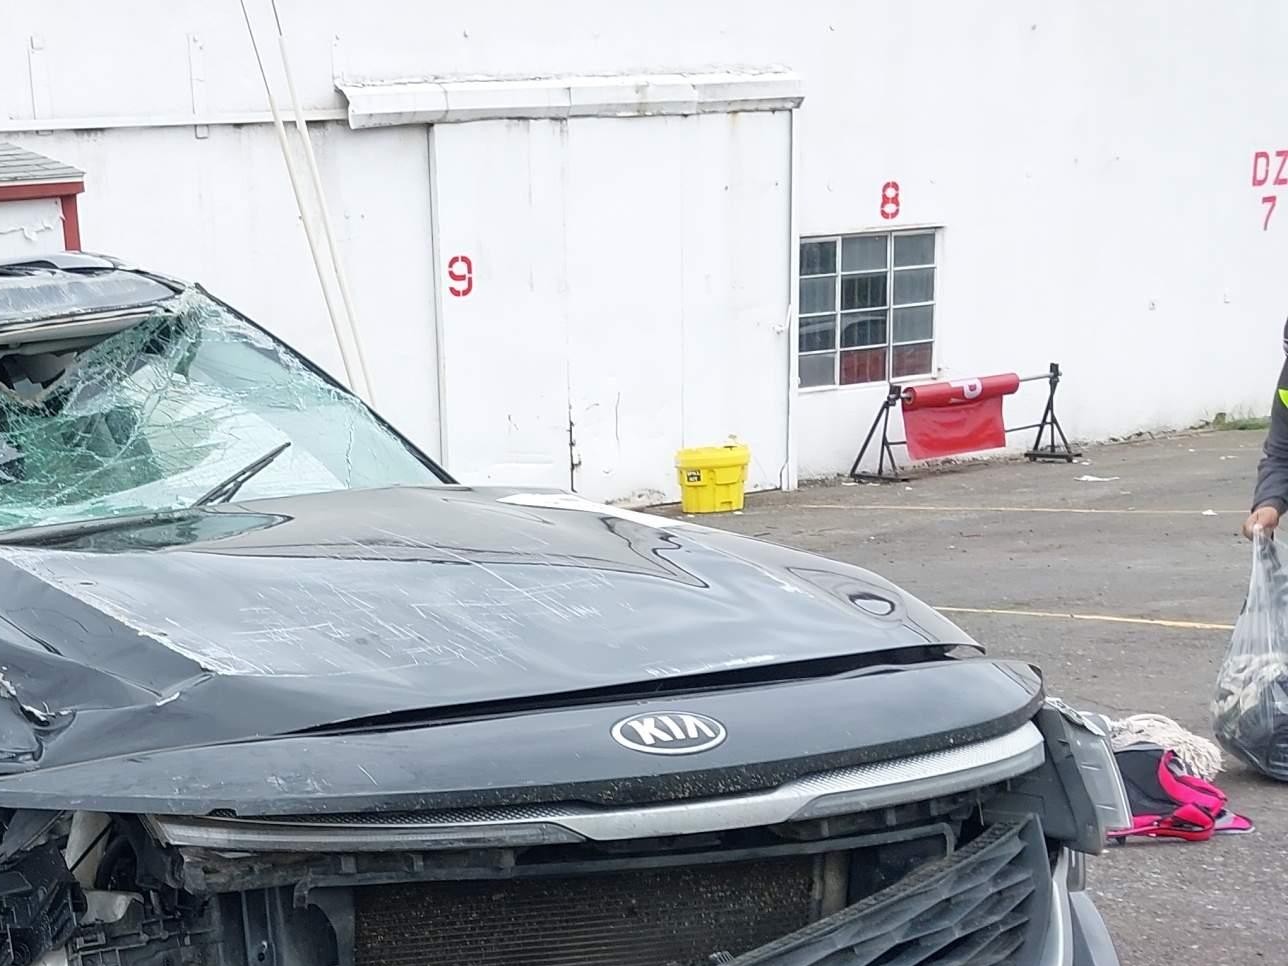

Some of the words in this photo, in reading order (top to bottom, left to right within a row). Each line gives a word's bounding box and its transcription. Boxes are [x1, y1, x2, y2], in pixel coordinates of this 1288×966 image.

[879, 181, 901, 221] 8
[1261, 195, 1278, 232] 7
[447, 255, 474, 298] 9
[627, 714, 717, 745] KIA
